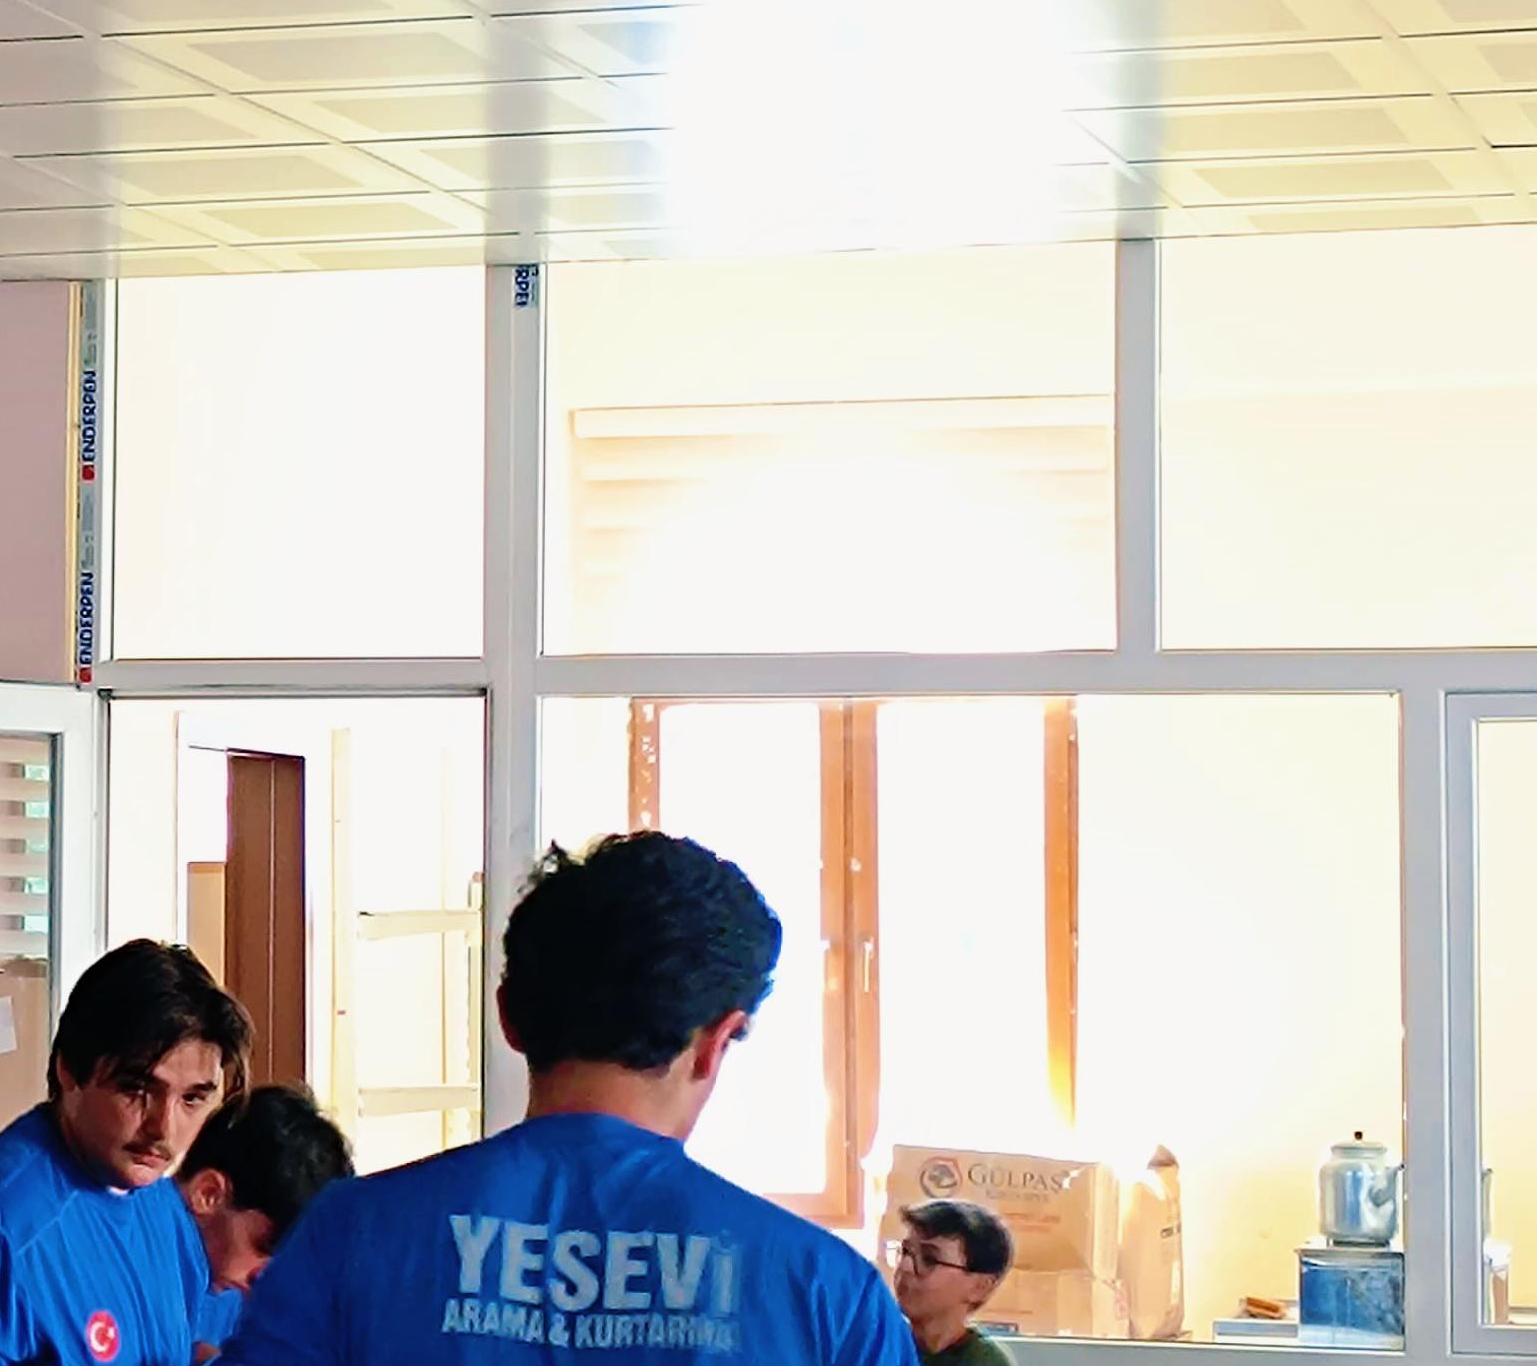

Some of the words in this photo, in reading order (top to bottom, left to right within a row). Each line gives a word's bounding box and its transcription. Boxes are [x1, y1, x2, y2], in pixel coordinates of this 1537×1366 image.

[82, 370, 97, 463] ENDERPEN
[79, 573, 95, 665] ENDERPEN
[442, 1298, 544, 1344] ARAMA
[548, 1315, 569, 1349] &
[575, 1313, 742, 1354] KURTARMA
